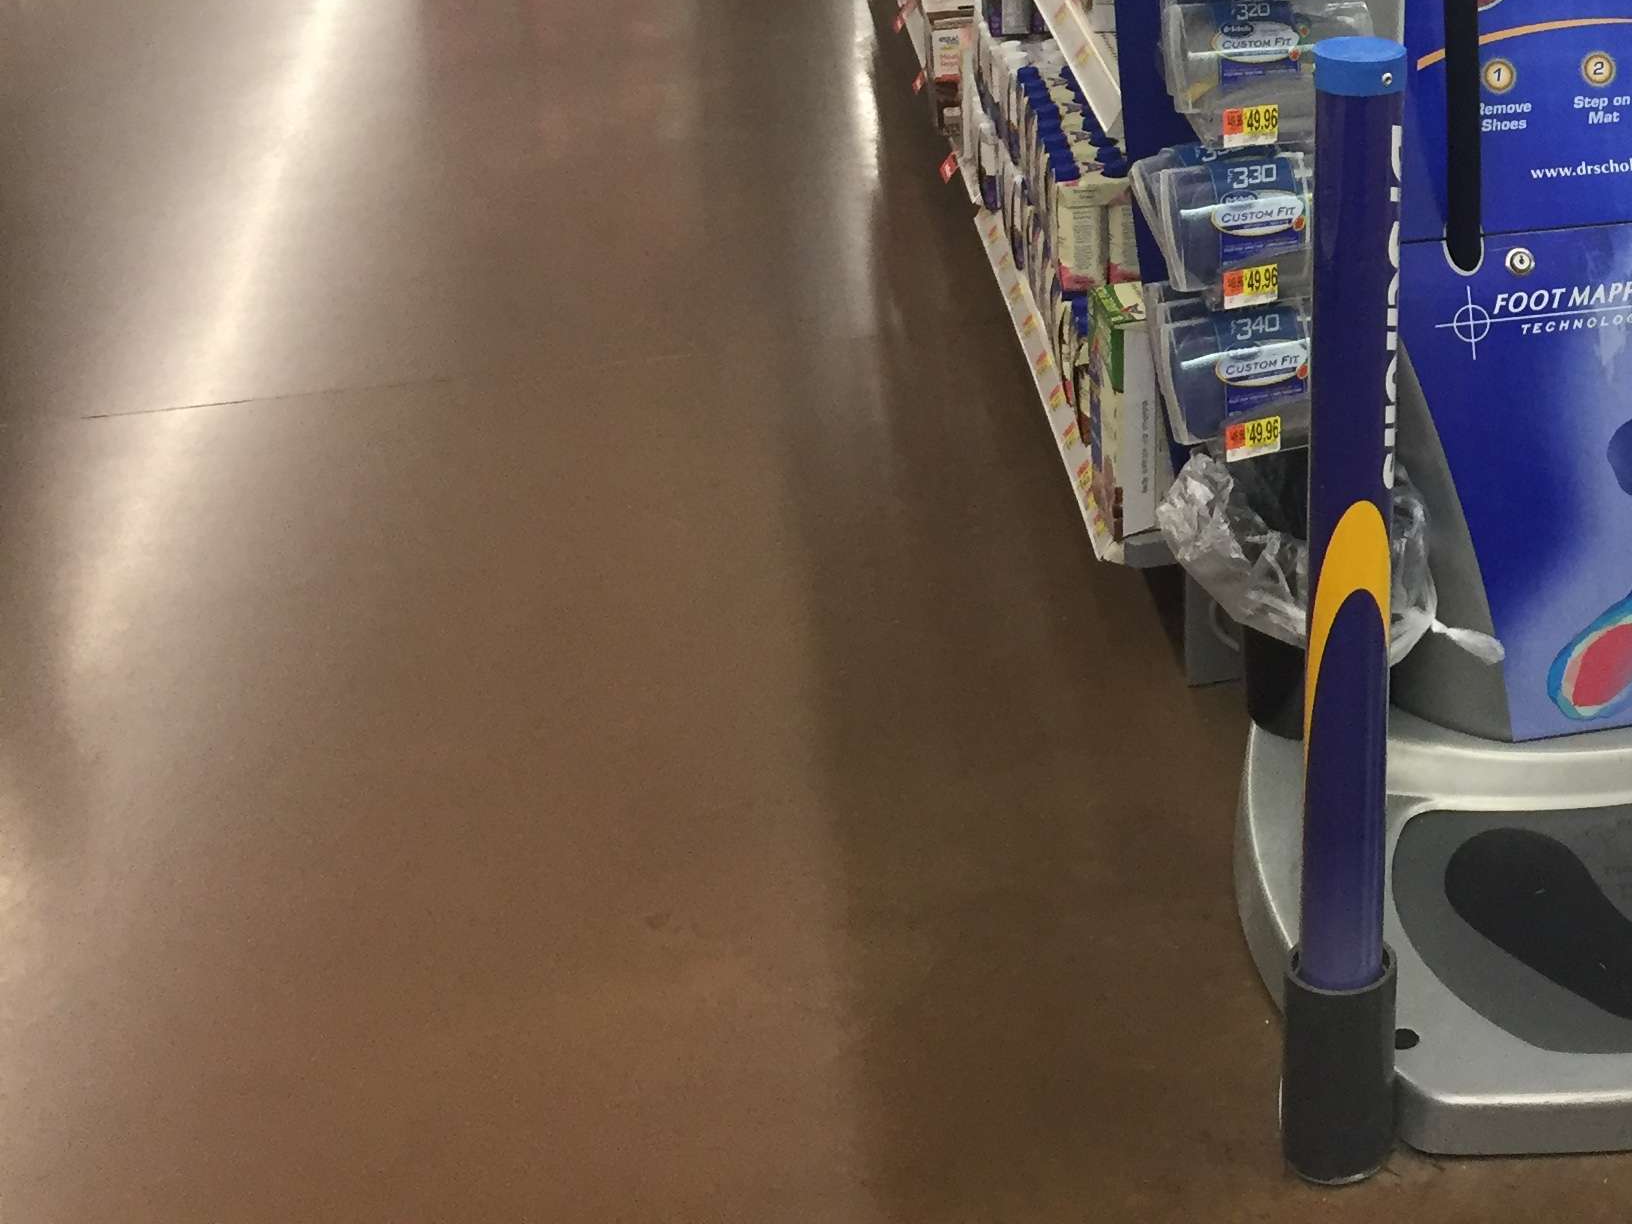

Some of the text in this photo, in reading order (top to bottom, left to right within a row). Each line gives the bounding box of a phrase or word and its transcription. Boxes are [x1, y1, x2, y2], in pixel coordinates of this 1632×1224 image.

[1493, 68, 1503, 82] 1
[1593, 62, 1604, 75] 2
[1574, 94, 1631, 110] Step on
[1481, 117, 1527, 133] Shoes
[1588, 111, 1620, 125] Mat
[1493, 287, 1565, 314] FOOT
